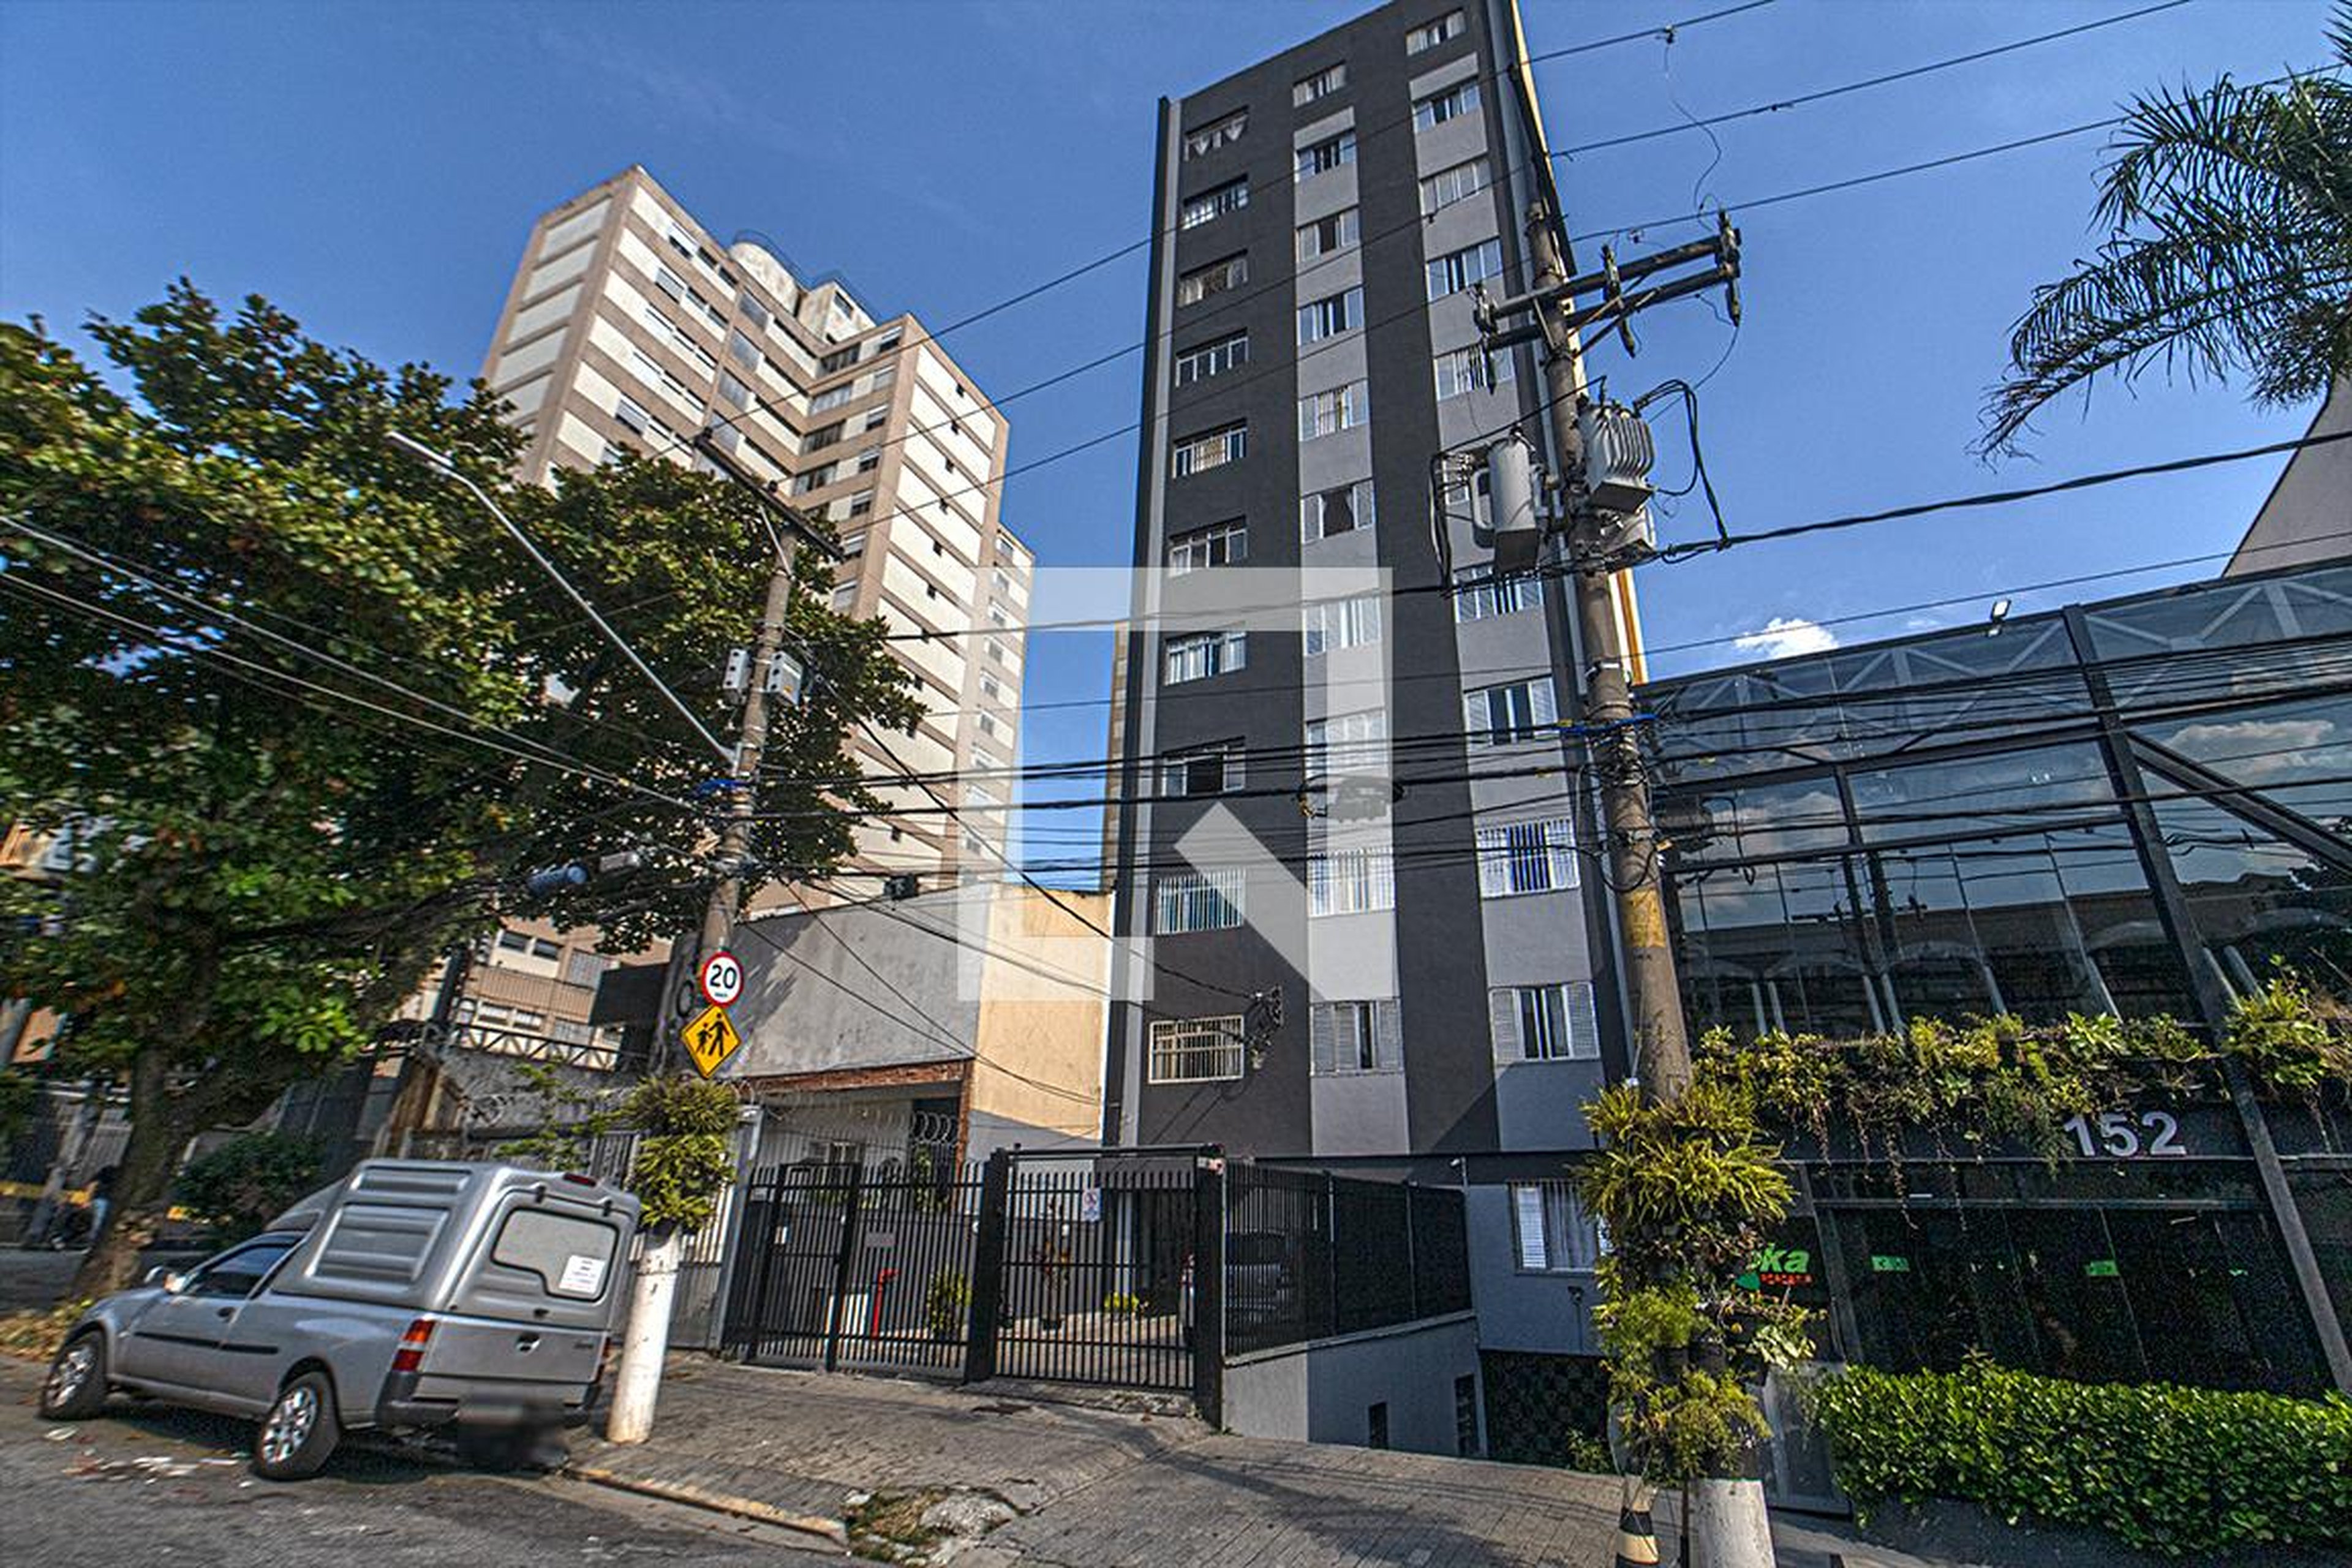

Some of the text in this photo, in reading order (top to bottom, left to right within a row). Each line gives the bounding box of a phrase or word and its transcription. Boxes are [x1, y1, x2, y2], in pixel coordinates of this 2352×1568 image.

[710, 963, 737, 989] 20
[2064, 1110, 2187, 1156] 152
[1754, 1242, 1810, 1273] ka
